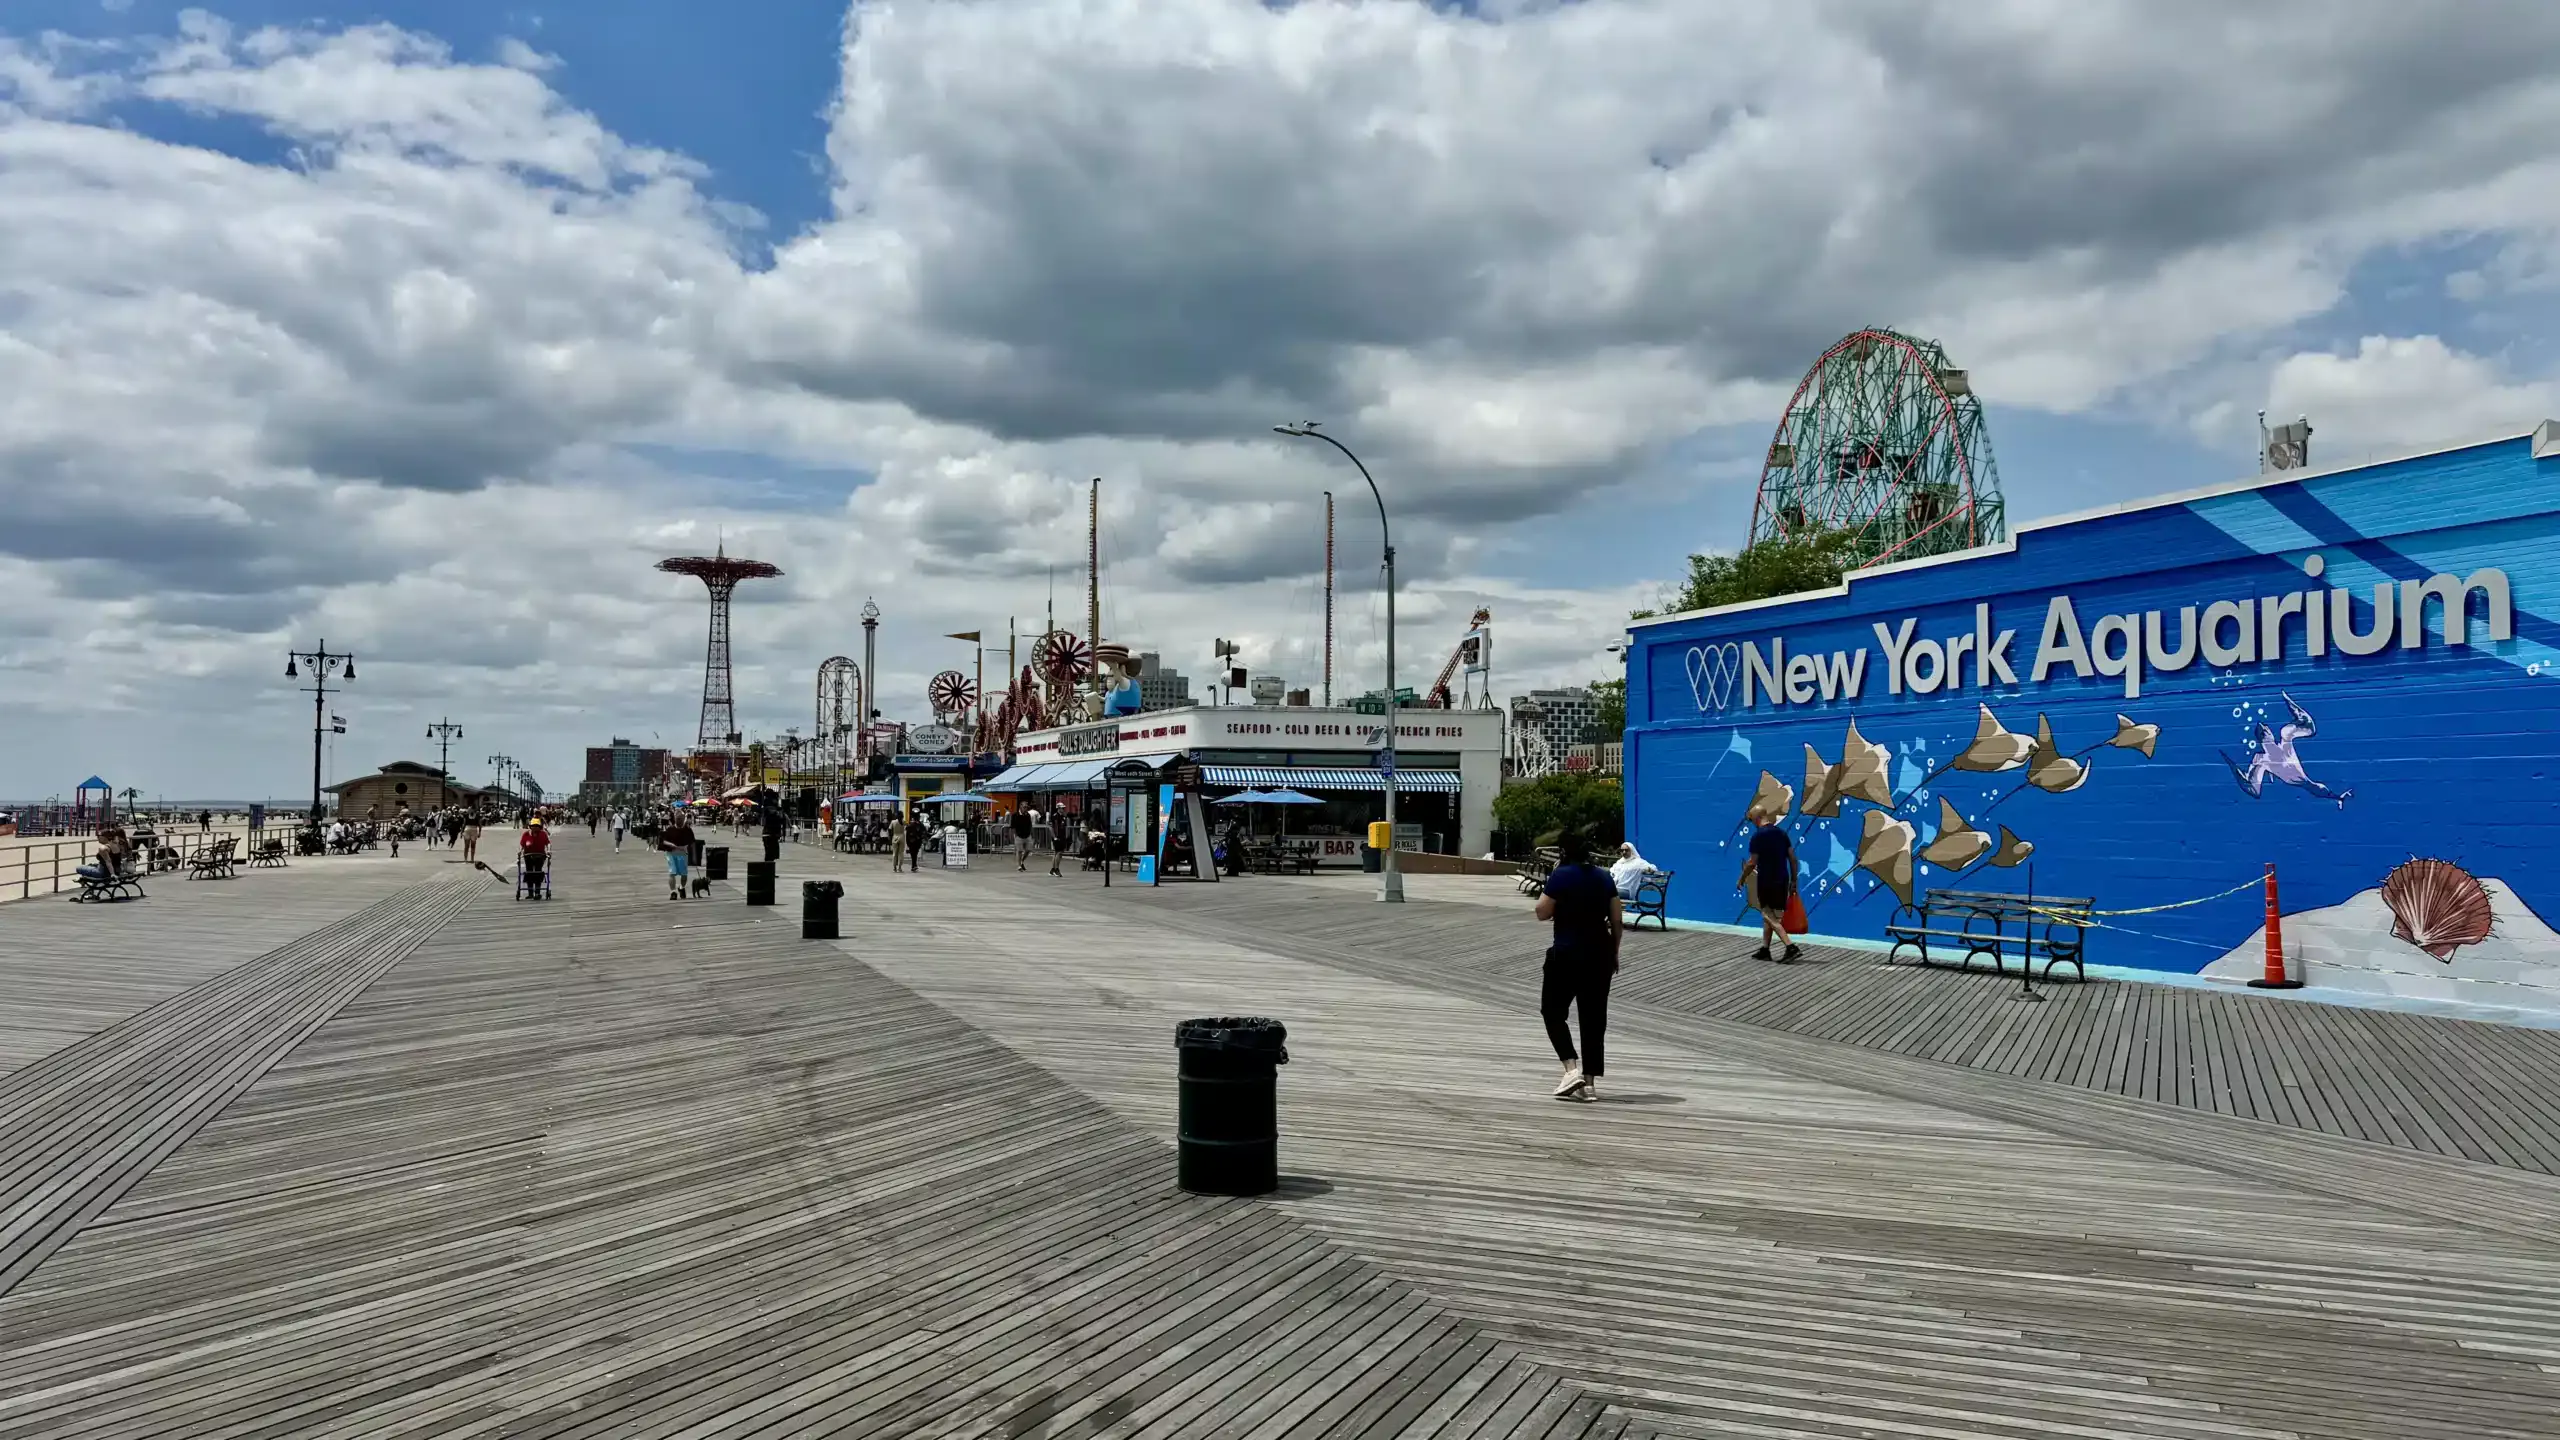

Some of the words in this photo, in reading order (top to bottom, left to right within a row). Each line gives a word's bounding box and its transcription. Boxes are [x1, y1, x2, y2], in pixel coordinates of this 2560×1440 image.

[1742, 637, 1867, 707] New
[1873, 602, 2016, 694] York
[2031, 554, 2512, 698] Aquarium
[1360, 704, 1366, 712] W
[1368, 704, 1376, 713] 10
[1227, 723, 1272, 734] SEAFOOD
[1285, 724, 1310, 735] COLD
[1315, 725, 1340, 735] BEER
[1345, 725, 1351, 735] &
[1394, 726, 1431, 737] FRENCH
[1435, 726, 1463, 737] FRIES
[1080, 728, 1117, 750] DAUGHTER
[1325, 840, 1355, 855] BAR
